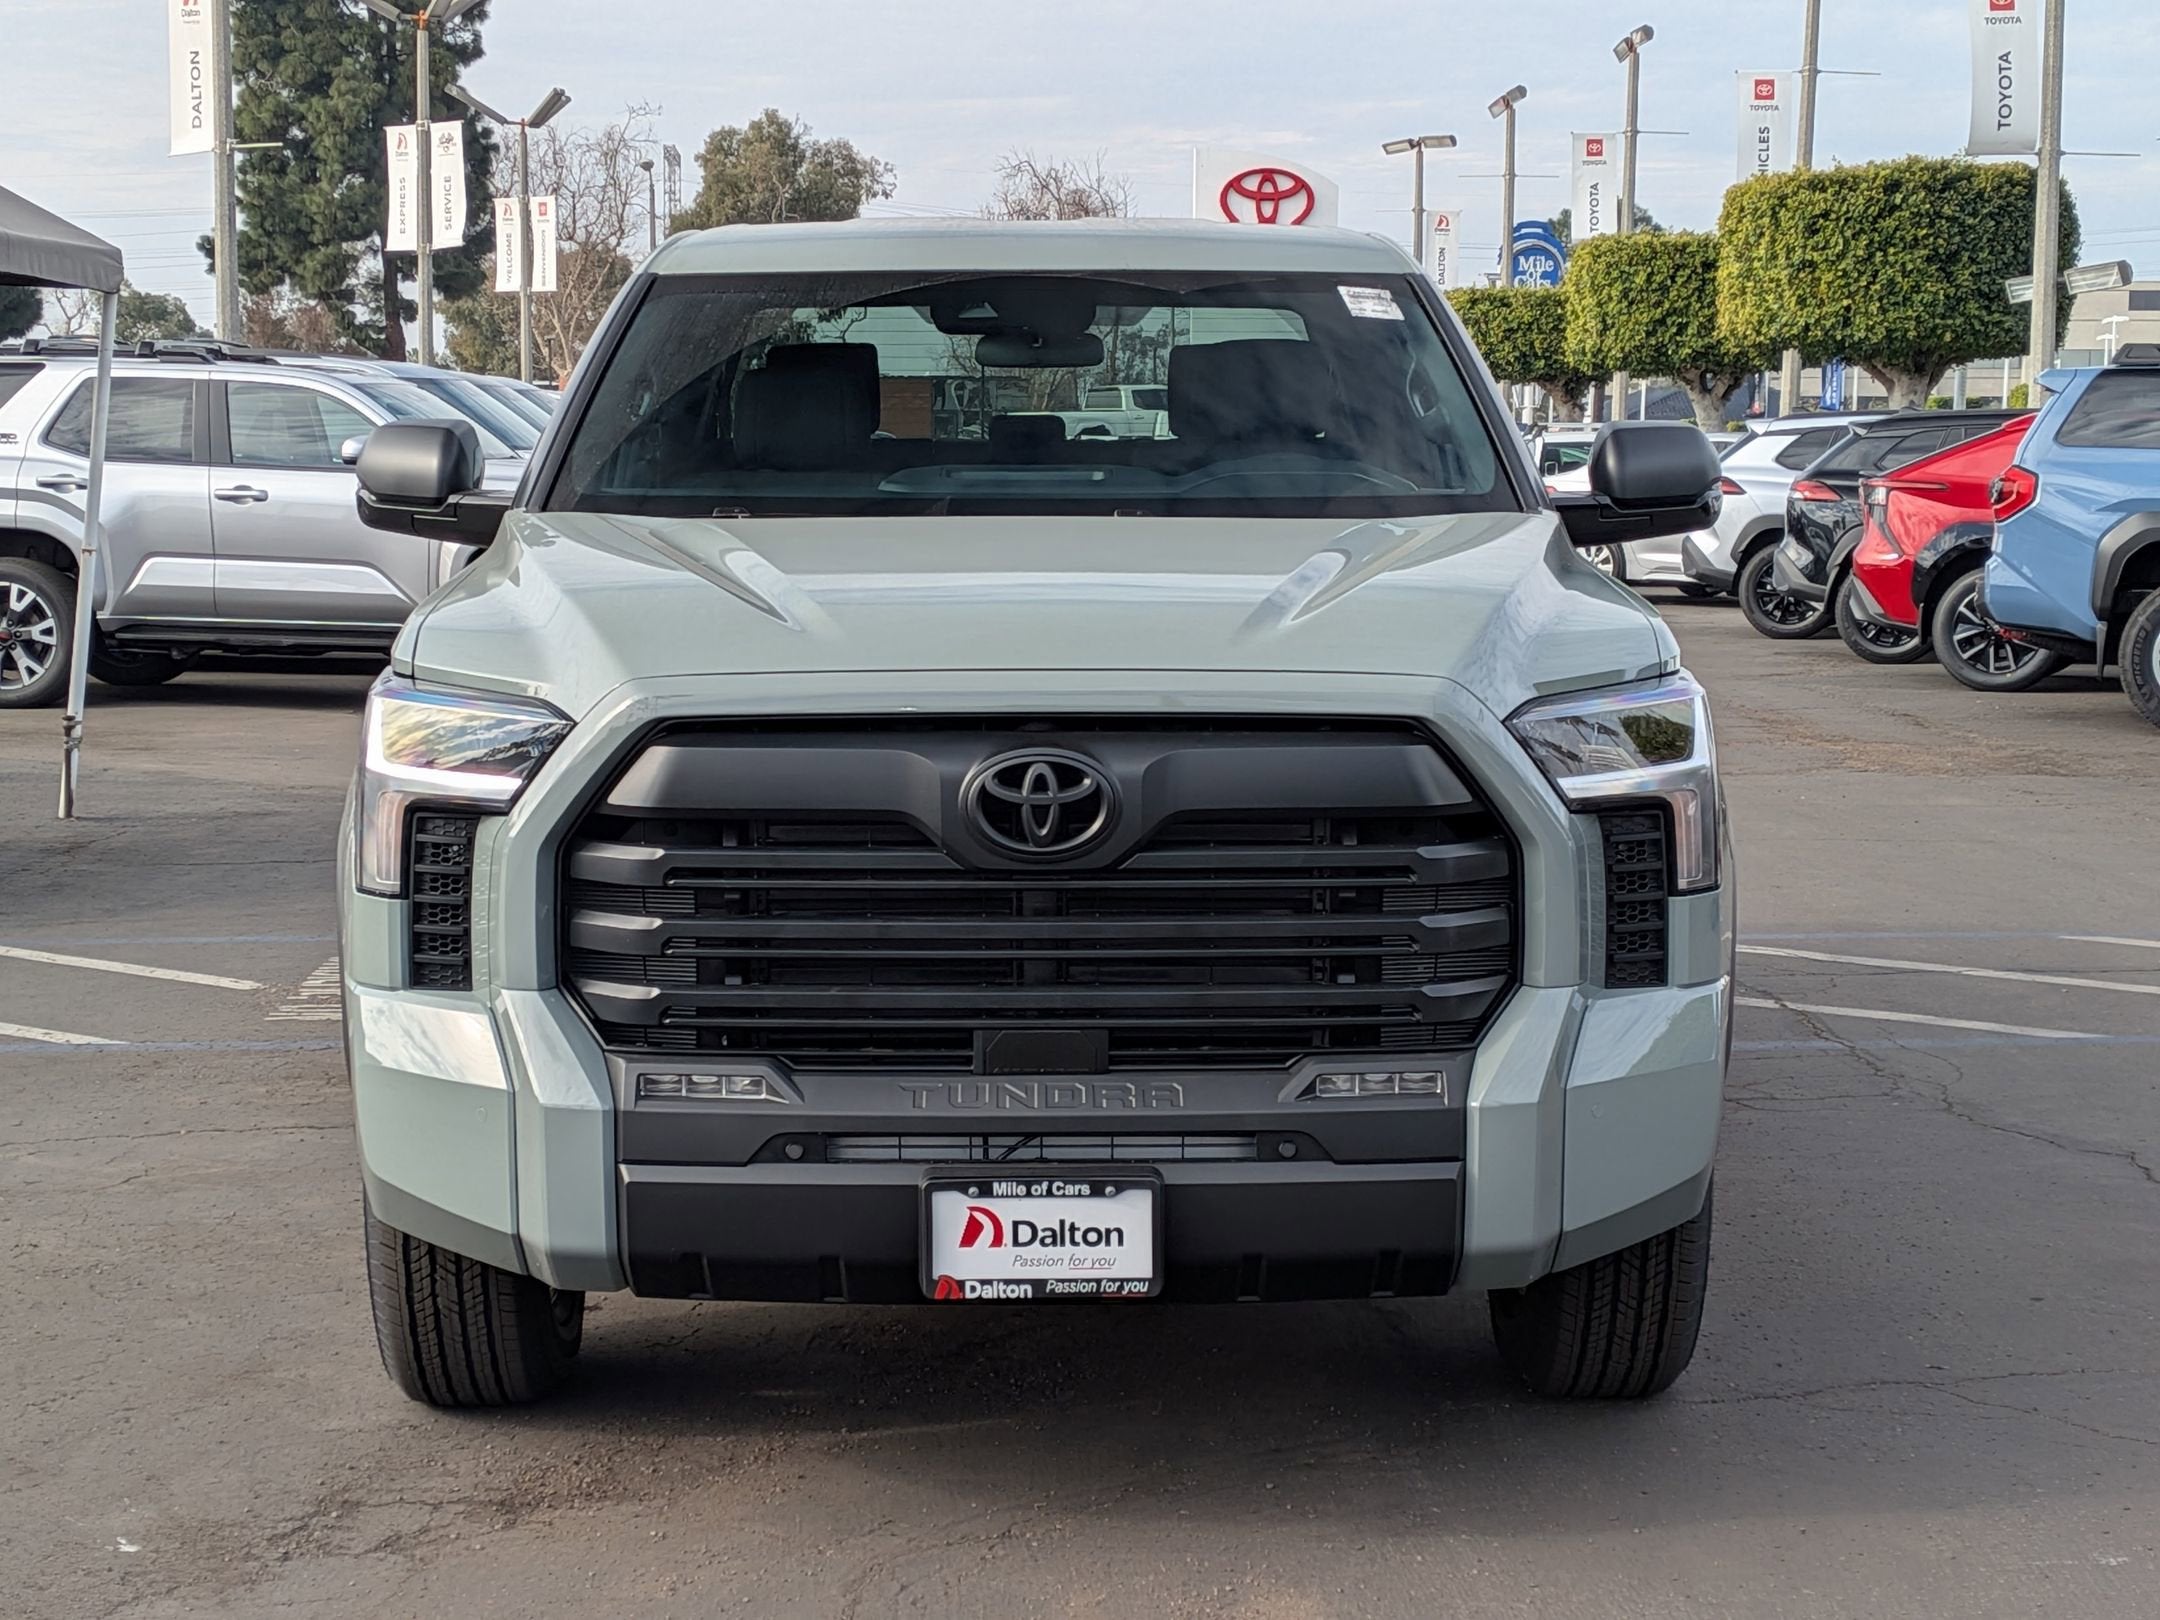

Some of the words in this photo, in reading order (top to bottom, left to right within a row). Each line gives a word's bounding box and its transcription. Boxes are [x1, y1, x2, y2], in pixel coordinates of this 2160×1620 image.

[1984, 16, 2022, 25] TOYOTA
[190, 51, 202, 129] DALTON
[1997, 50, 2013, 131] TOYOTA
[443, 176, 453, 231] SERVICE
[1589, 182, 1600, 233] TOYOTA
[1438, 247, 1447, 285] DALTON
[1518, 255, 1555, 271] Mile
[897, 1083, 1184, 1109] TUNDRA
[992, 1182, 1027, 1196] Mile
[1031, 1181, 1049, 1196] of
[1052, 1182, 1091, 1196] Cars
[1011, 1219, 1124, 1248] Dalton
[1012, 1254, 1064, 1267] Passion
[1068, 1253, 1087, 1268] for
[1091, 1256, 1117, 1269] you
[965, 1281, 1032, 1299] Dalton
[1046, 1280, 1097, 1293] Passion
[1100, 1279, 1119, 1294] for
[1121, 1281, 1148, 1294] you
